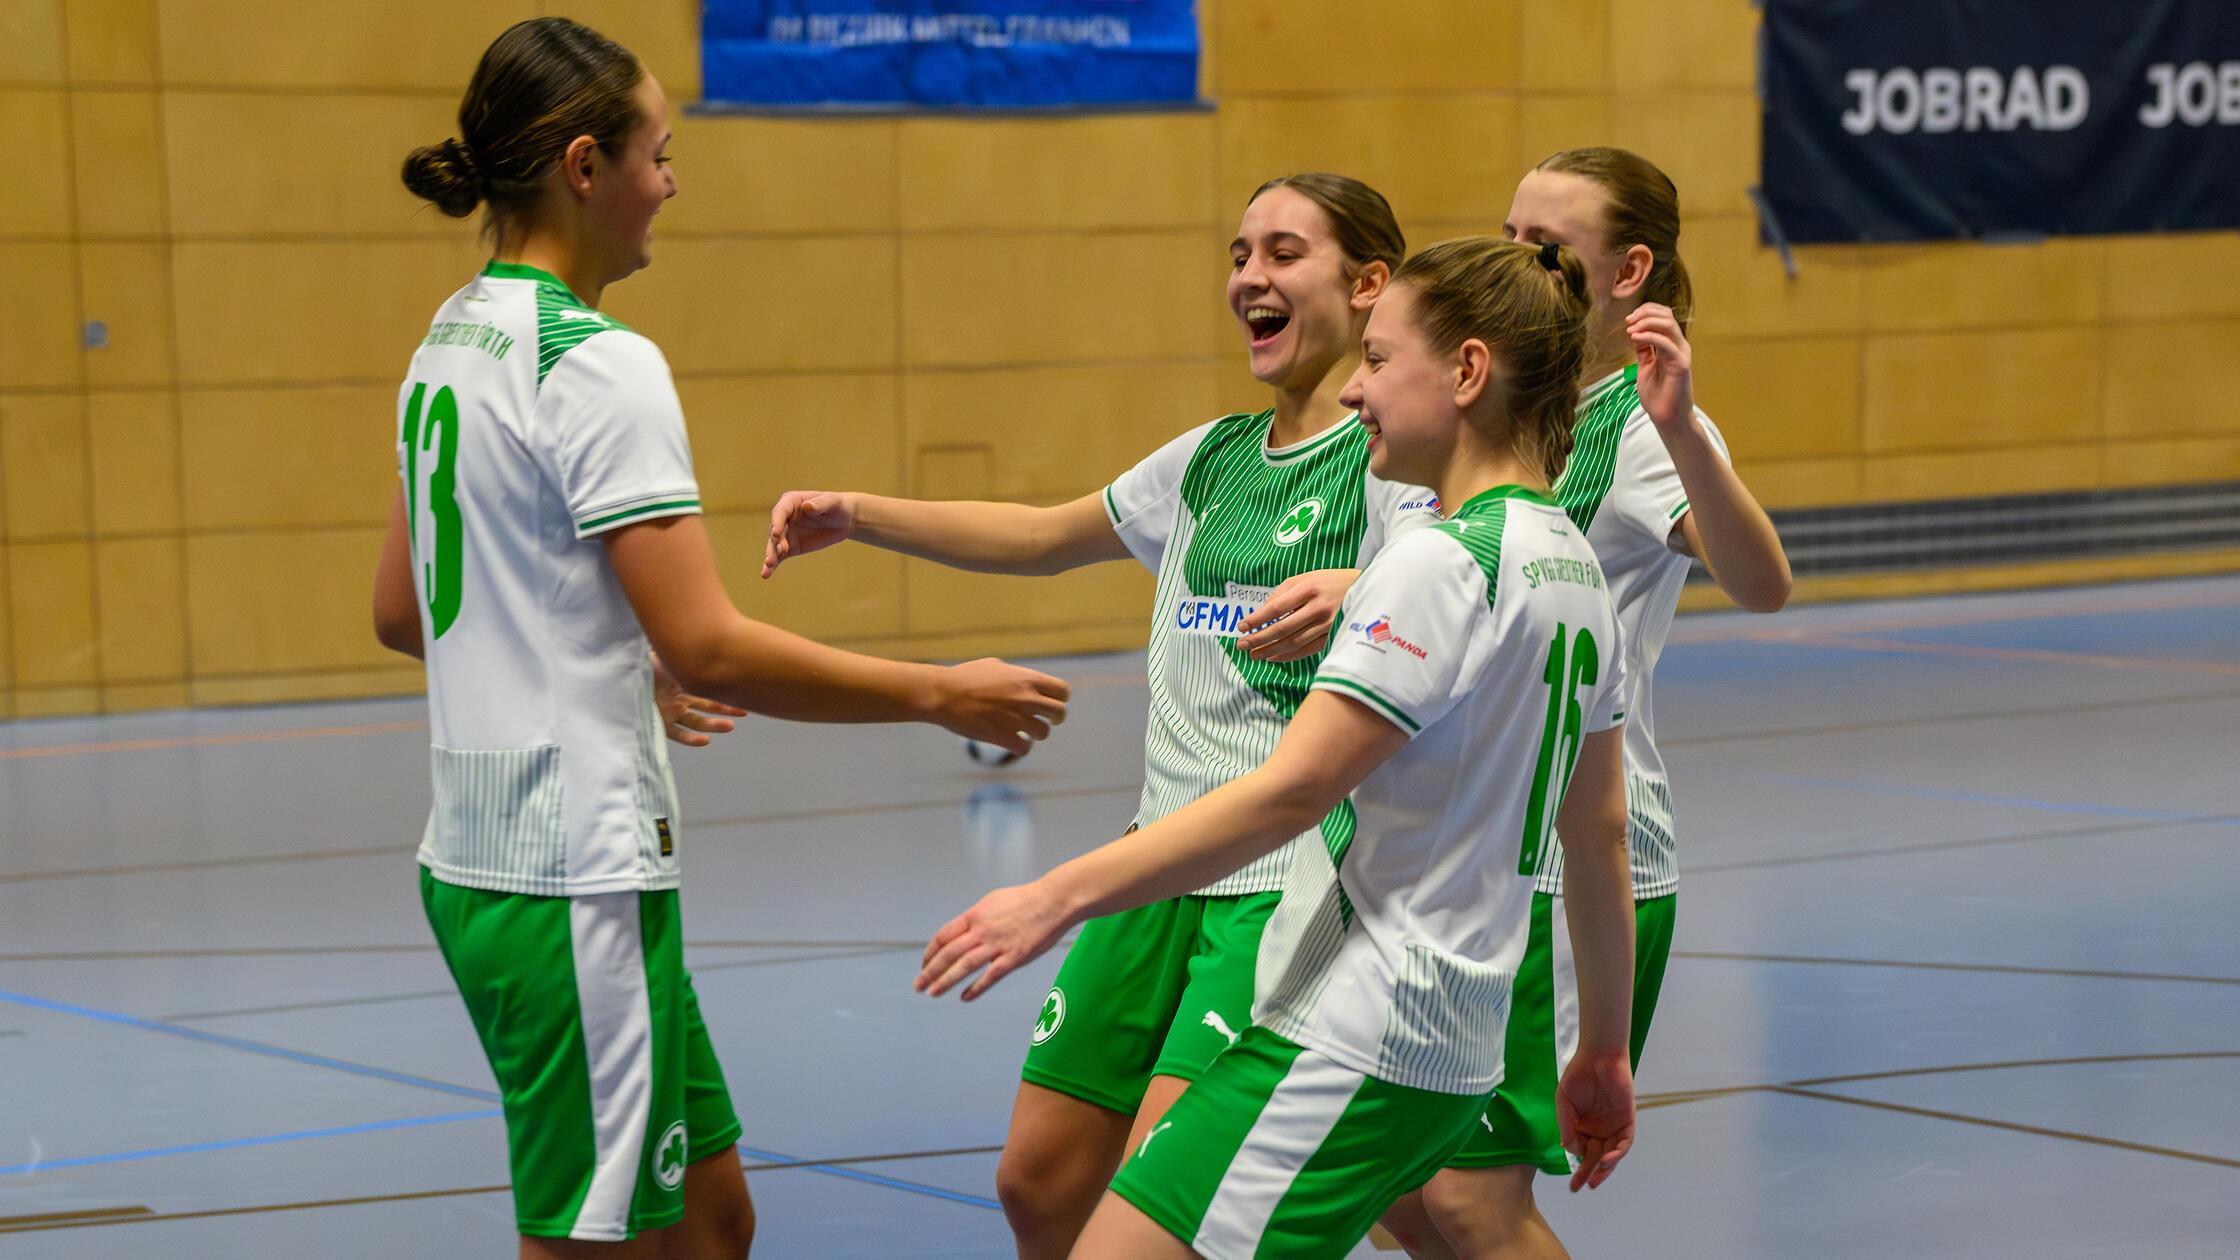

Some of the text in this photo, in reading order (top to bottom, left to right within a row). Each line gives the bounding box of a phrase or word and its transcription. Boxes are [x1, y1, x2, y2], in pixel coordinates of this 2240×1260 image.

[1842, 66, 2089, 135] JOBRAD
[403, 382, 463, 640] 13
[1391, 636, 1427, 660] PANDA
[1518, 621, 1599, 877] 16
